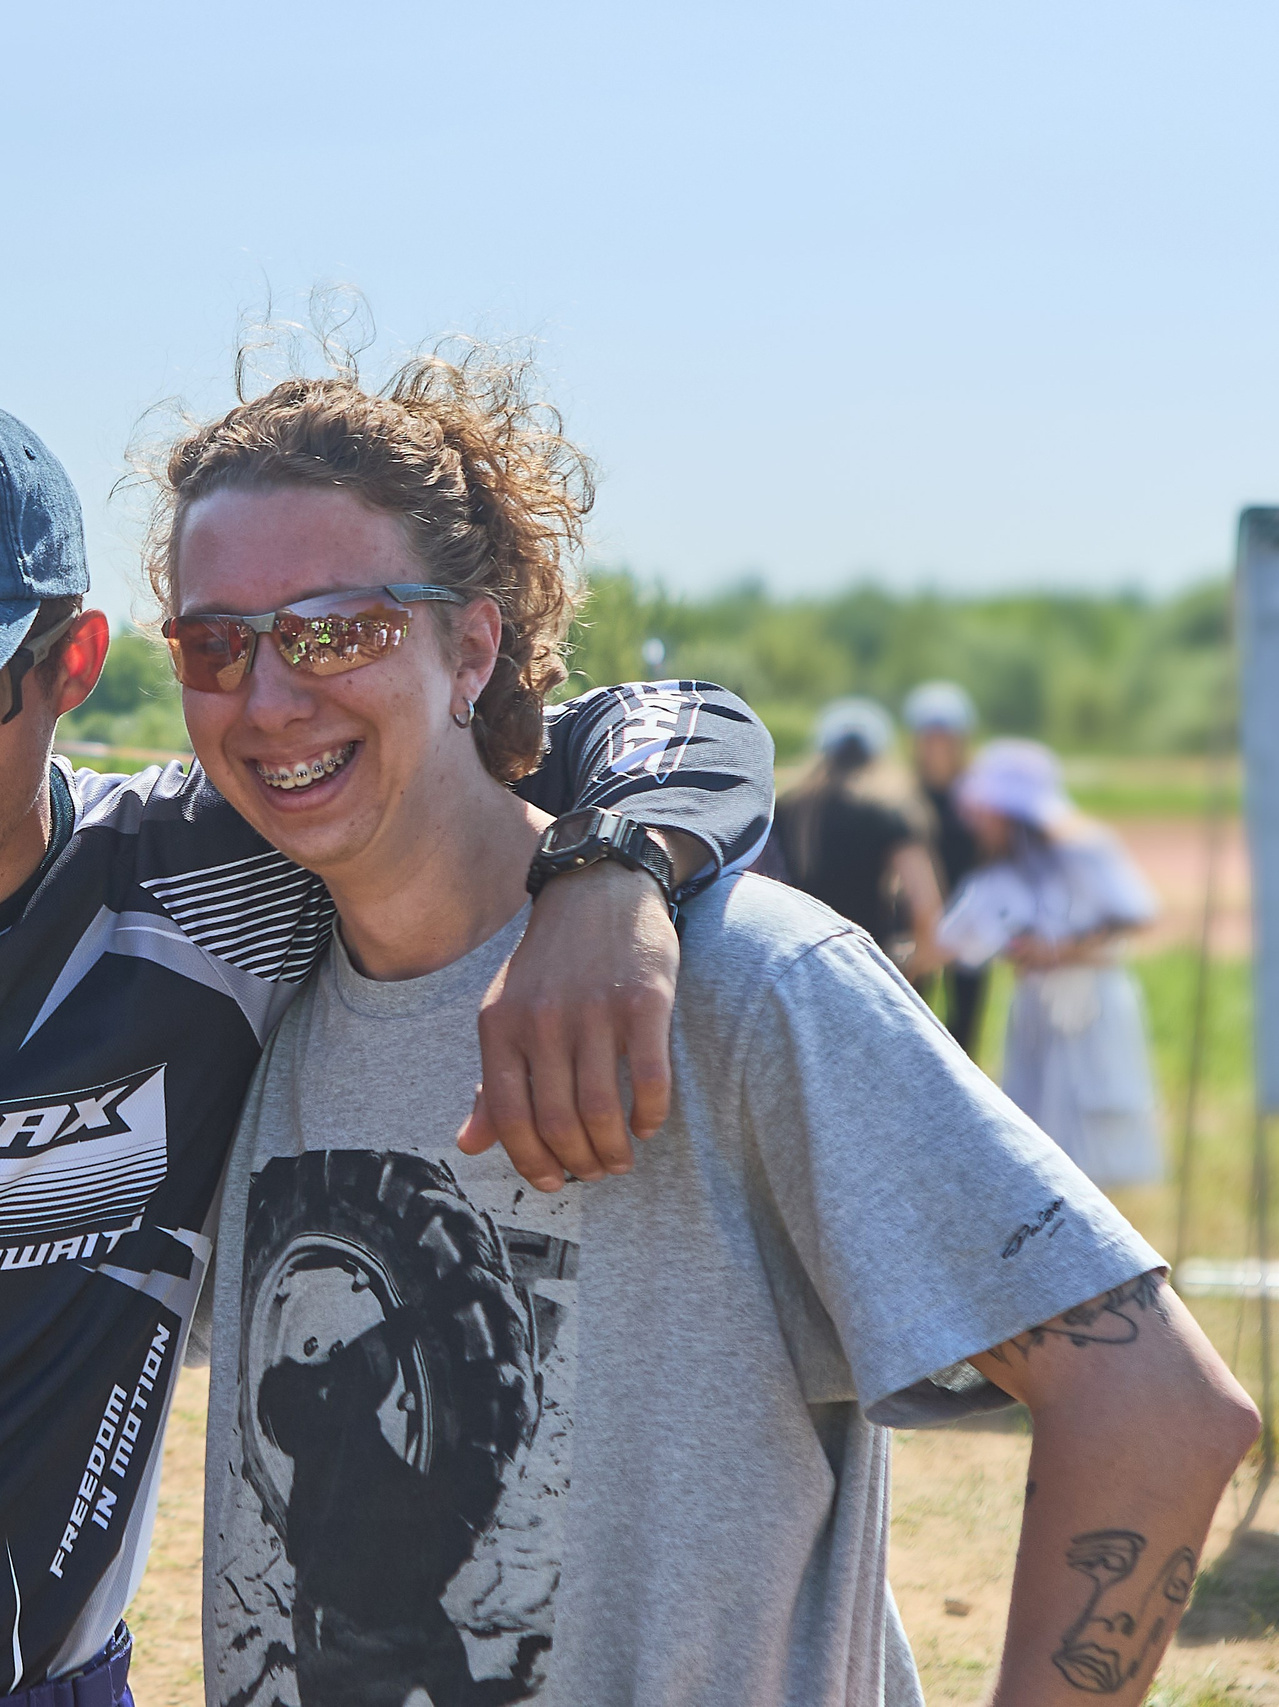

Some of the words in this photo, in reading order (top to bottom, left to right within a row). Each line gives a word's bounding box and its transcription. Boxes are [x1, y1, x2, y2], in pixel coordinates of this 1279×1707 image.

[49, 1383, 128, 1579] FREEDOM
[91, 1485, 118, 1531] IN
[109, 1323, 171, 1478] MOTION
